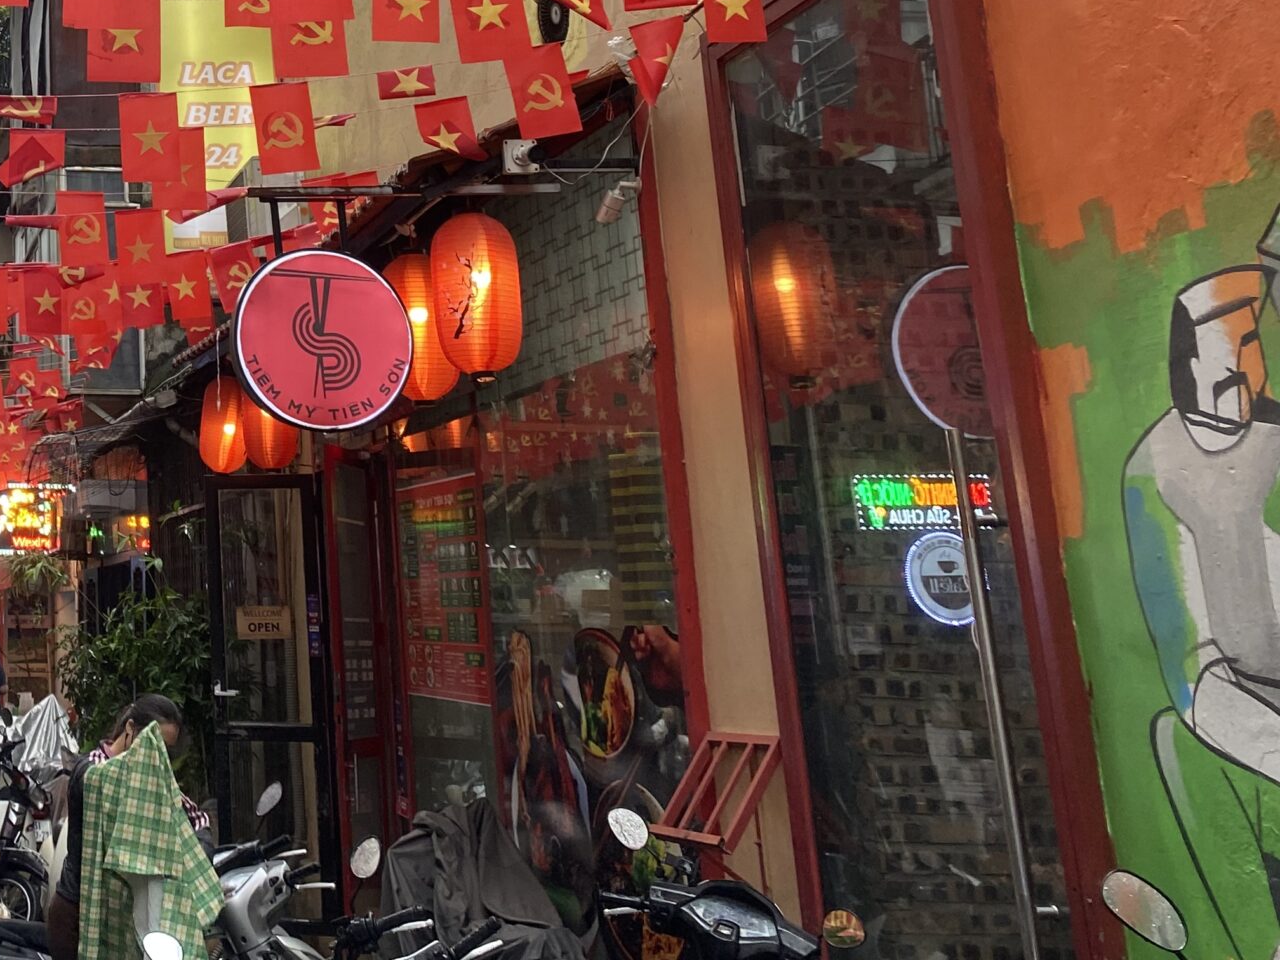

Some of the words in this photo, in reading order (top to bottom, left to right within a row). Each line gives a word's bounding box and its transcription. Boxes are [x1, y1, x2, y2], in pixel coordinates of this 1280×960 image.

[179, 61, 253, 86] LACA
[184, 102, 253, 127] BEER
[205, 144, 241, 168] 24
[248, 622, 280, 632] OPEN
